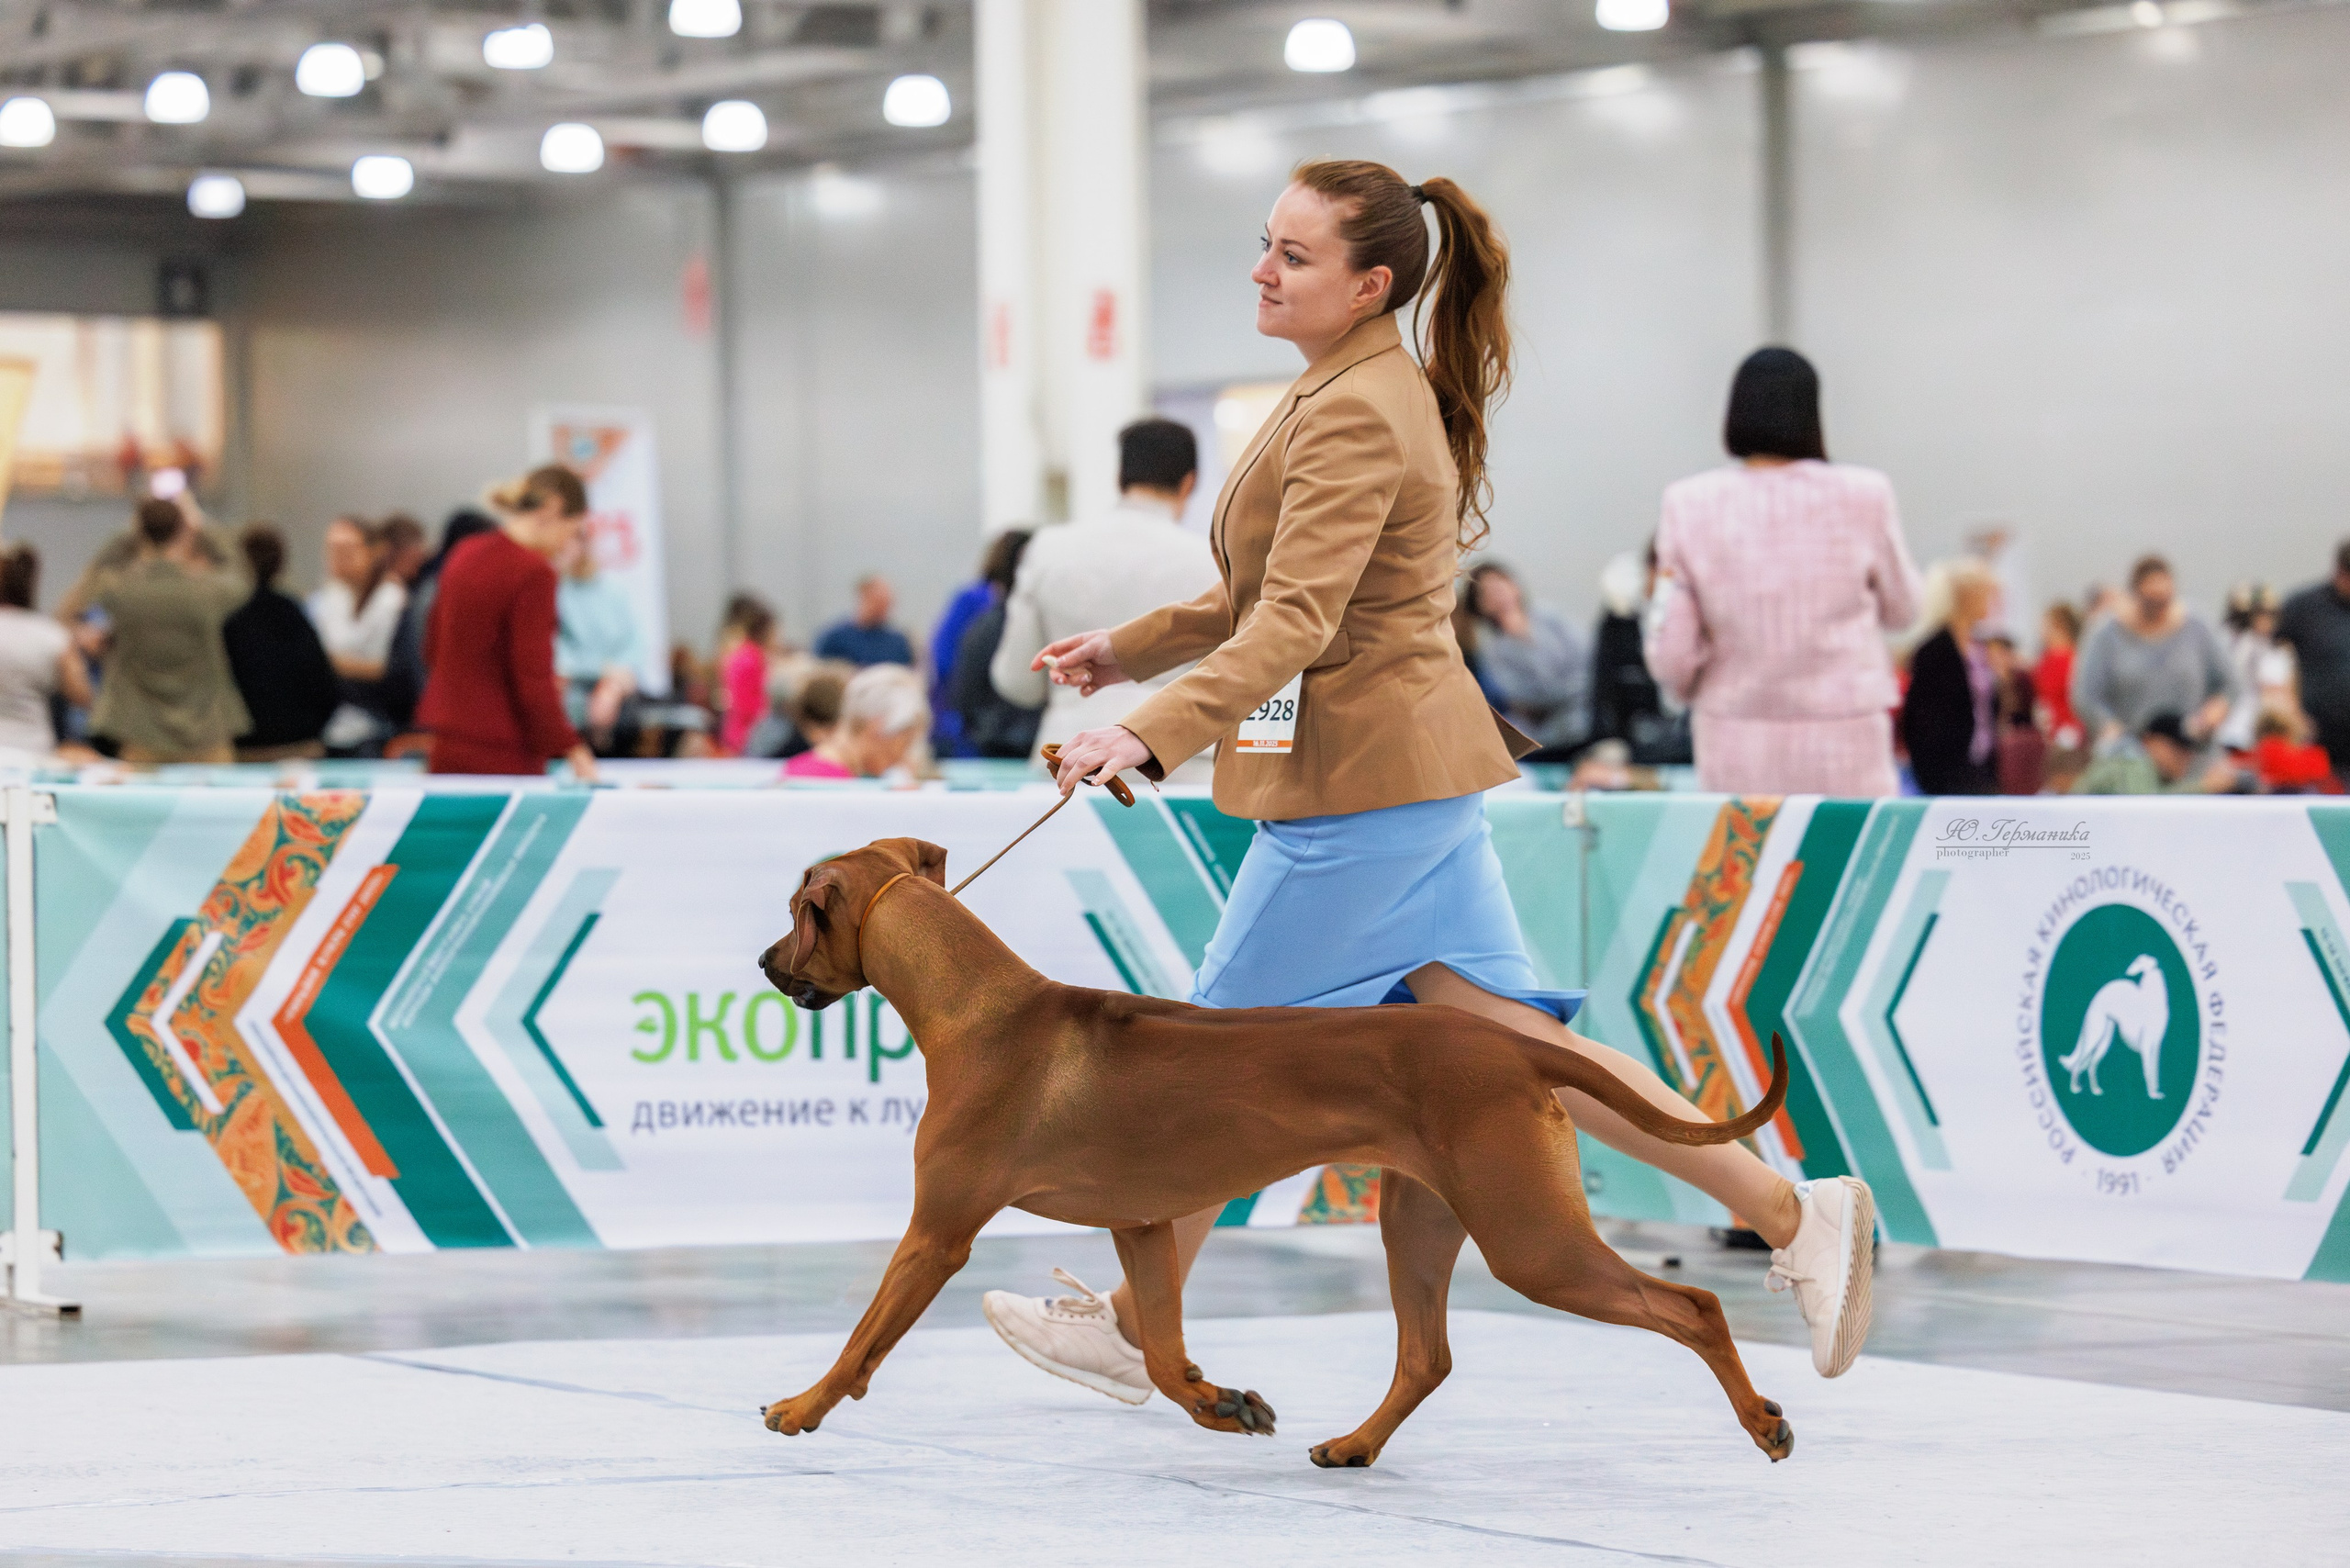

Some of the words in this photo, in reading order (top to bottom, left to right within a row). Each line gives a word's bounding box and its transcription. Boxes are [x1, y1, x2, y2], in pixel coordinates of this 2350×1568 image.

[1246, 700, 1294, 721] 928
[2035, 866, 2218, 981] КИНОЛОГИЧЕСКАЯ
[2016, 946, 2076, 1164] РОССИЙСКАЯ
[2162, 991, 2226, 1175] ФЕДЕРАЦИЯ
[631, 1098, 835, 1134] движение
[848, 1101, 868, 1125] к
[2097, 1167, 2141, 1196] 1991
